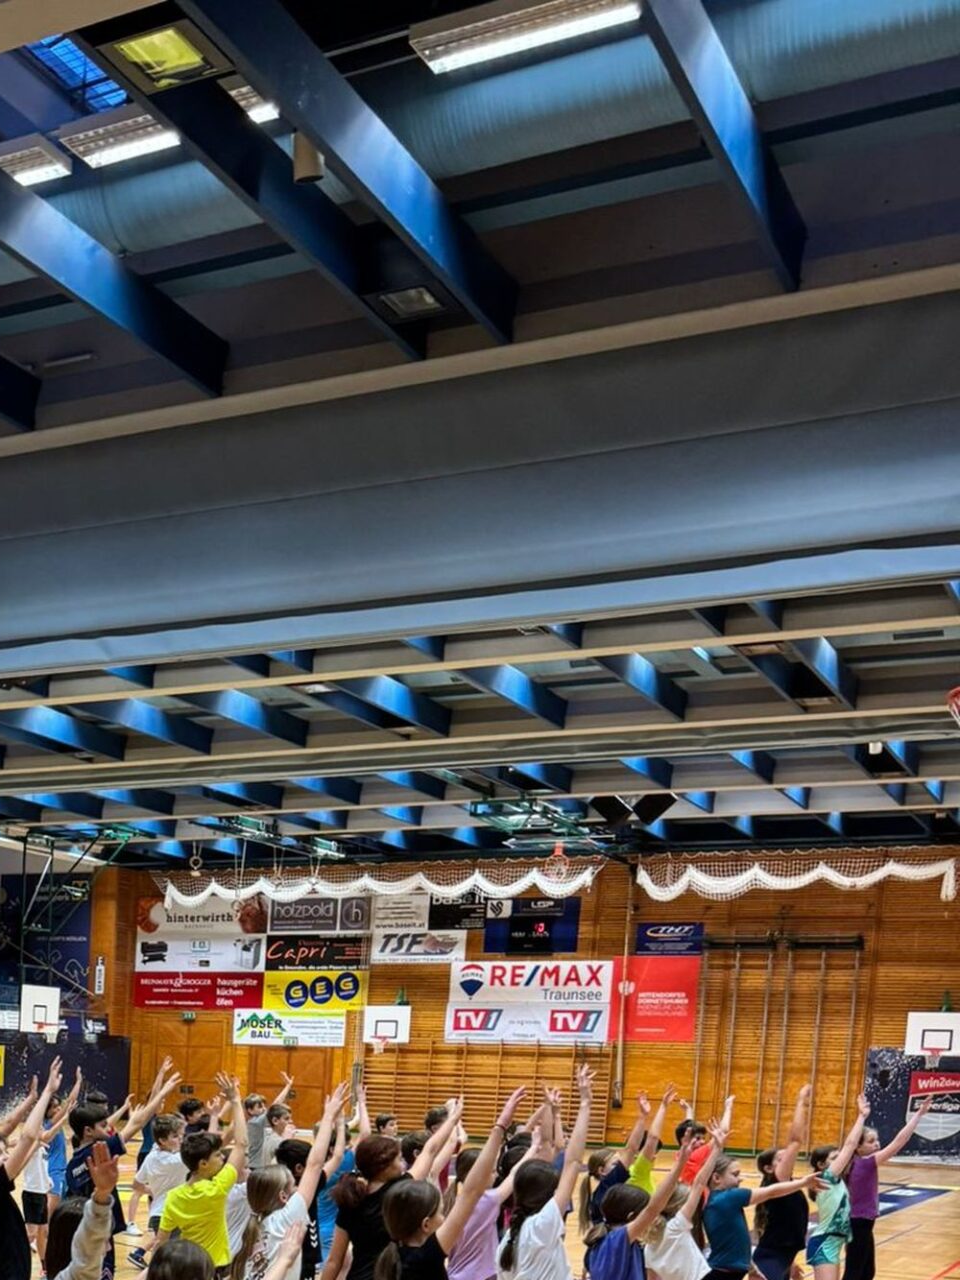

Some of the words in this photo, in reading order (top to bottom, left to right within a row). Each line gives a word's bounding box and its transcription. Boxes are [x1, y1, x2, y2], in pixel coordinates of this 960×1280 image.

[166, 912, 234, 924] hinterwirth
[378, 932, 429, 953] TSF
[267, 940, 330, 965] Capri
[490, 964, 605, 987] RE/MAX
[542, 988, 603, 1001] Traunsee
[240, 1019, 283, 1029] MOSER
[457, 1011, 499, 1030] TV1
[553, 1012, 600, 1032] TV1
[250, 1030, 271, 1039] BAU
